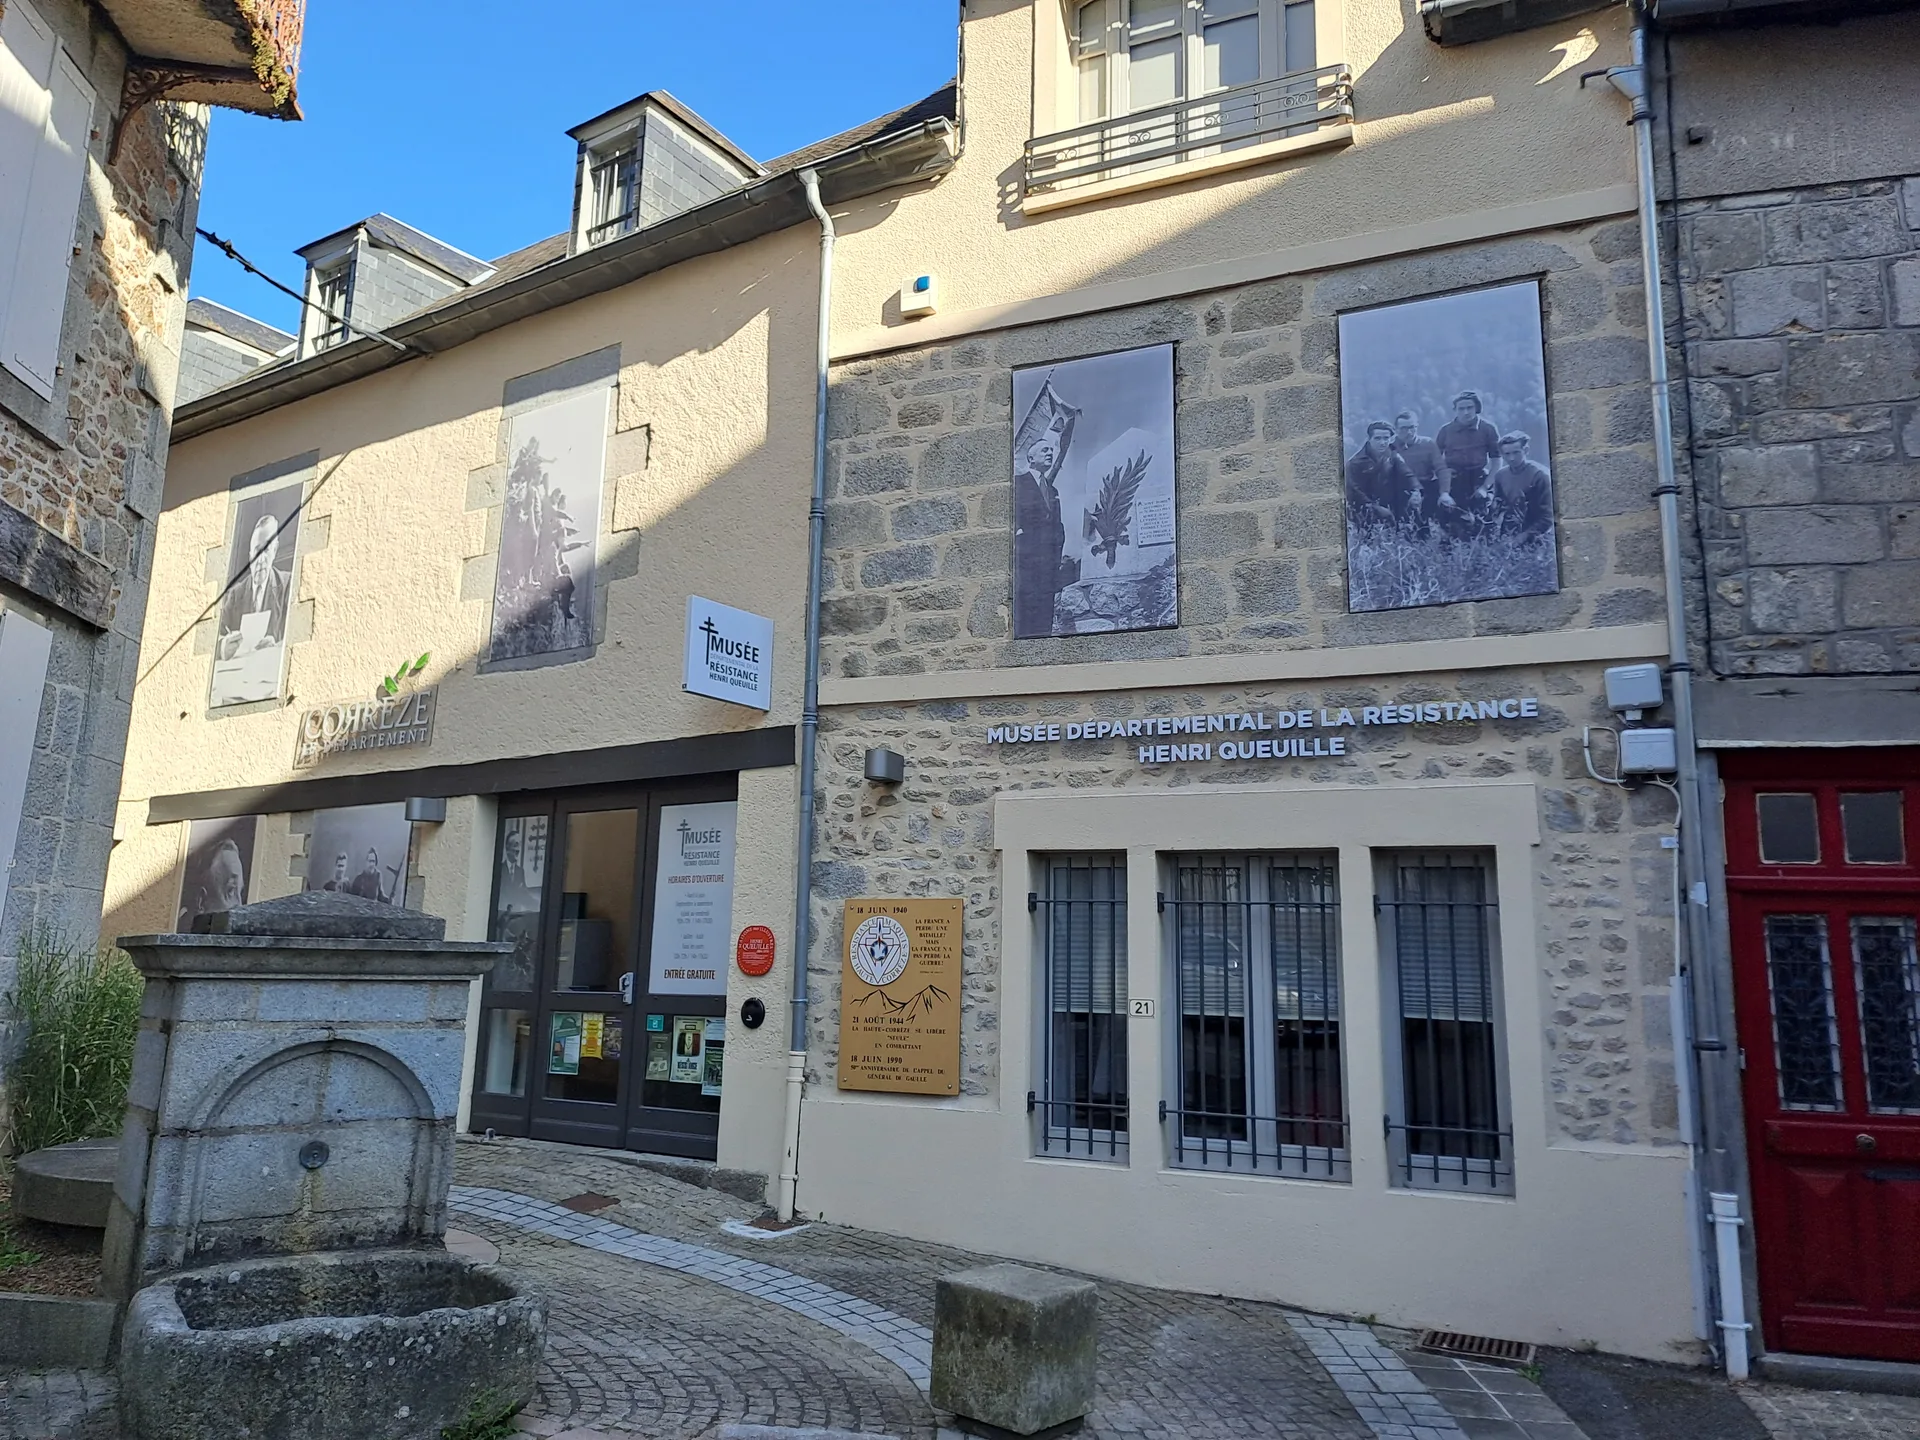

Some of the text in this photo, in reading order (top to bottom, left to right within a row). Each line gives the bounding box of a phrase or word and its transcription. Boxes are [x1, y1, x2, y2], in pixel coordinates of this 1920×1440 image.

[711, 634, 759, 663] MUSÉE
[710, 661, 759, 682] RÉSISTANCE
[709, 672, 758, 691] HENRI QUEUILLE
[987, 698, 1538, 744] MUSÉE DÉPARTEMENTAL DE LA RÉSISTANCE
[1139, 737, 1345, 763] HENRI QUEUILLE
[685, 828, 721, 844] MUSÉE
[664, 967, 716, 980] ENTRÉE GRATUITE
[1135, 1002, 1149, 1014] 21
[863, 1015, 885, 1024] AOÛT
[889, 1017, 904, 1025] 1944
[862, 1055, 882, 1063] JUIN
[887, 1056, 902, 1064] 1990
